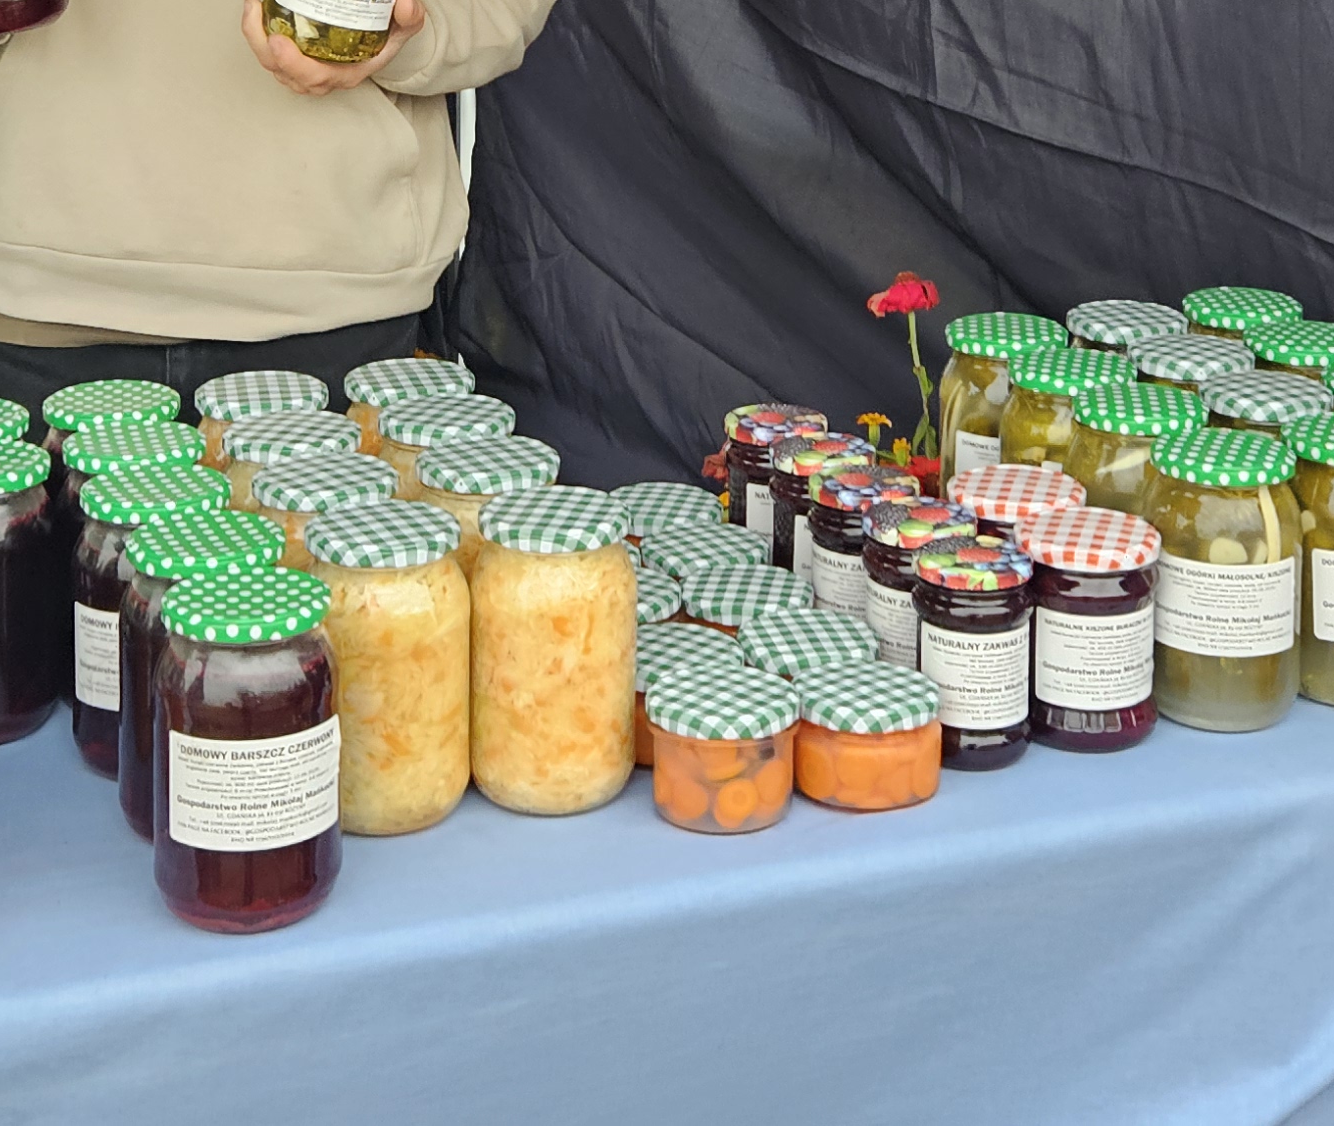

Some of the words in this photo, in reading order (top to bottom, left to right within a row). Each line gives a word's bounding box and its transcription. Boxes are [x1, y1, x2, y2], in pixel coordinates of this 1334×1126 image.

[927, 632, 980, 651] NATURALNY
[180, 744, 228, 761] DOMOWY
[231, 747, 285, 761] BARSZCZ
[288, 727, 335, 755] CZERWONY
[176, 794, 237, 811] Gospodarstwo
[240, 802, 268, 811] Rolne
[270, 794, 303, 809] Mikołaj
